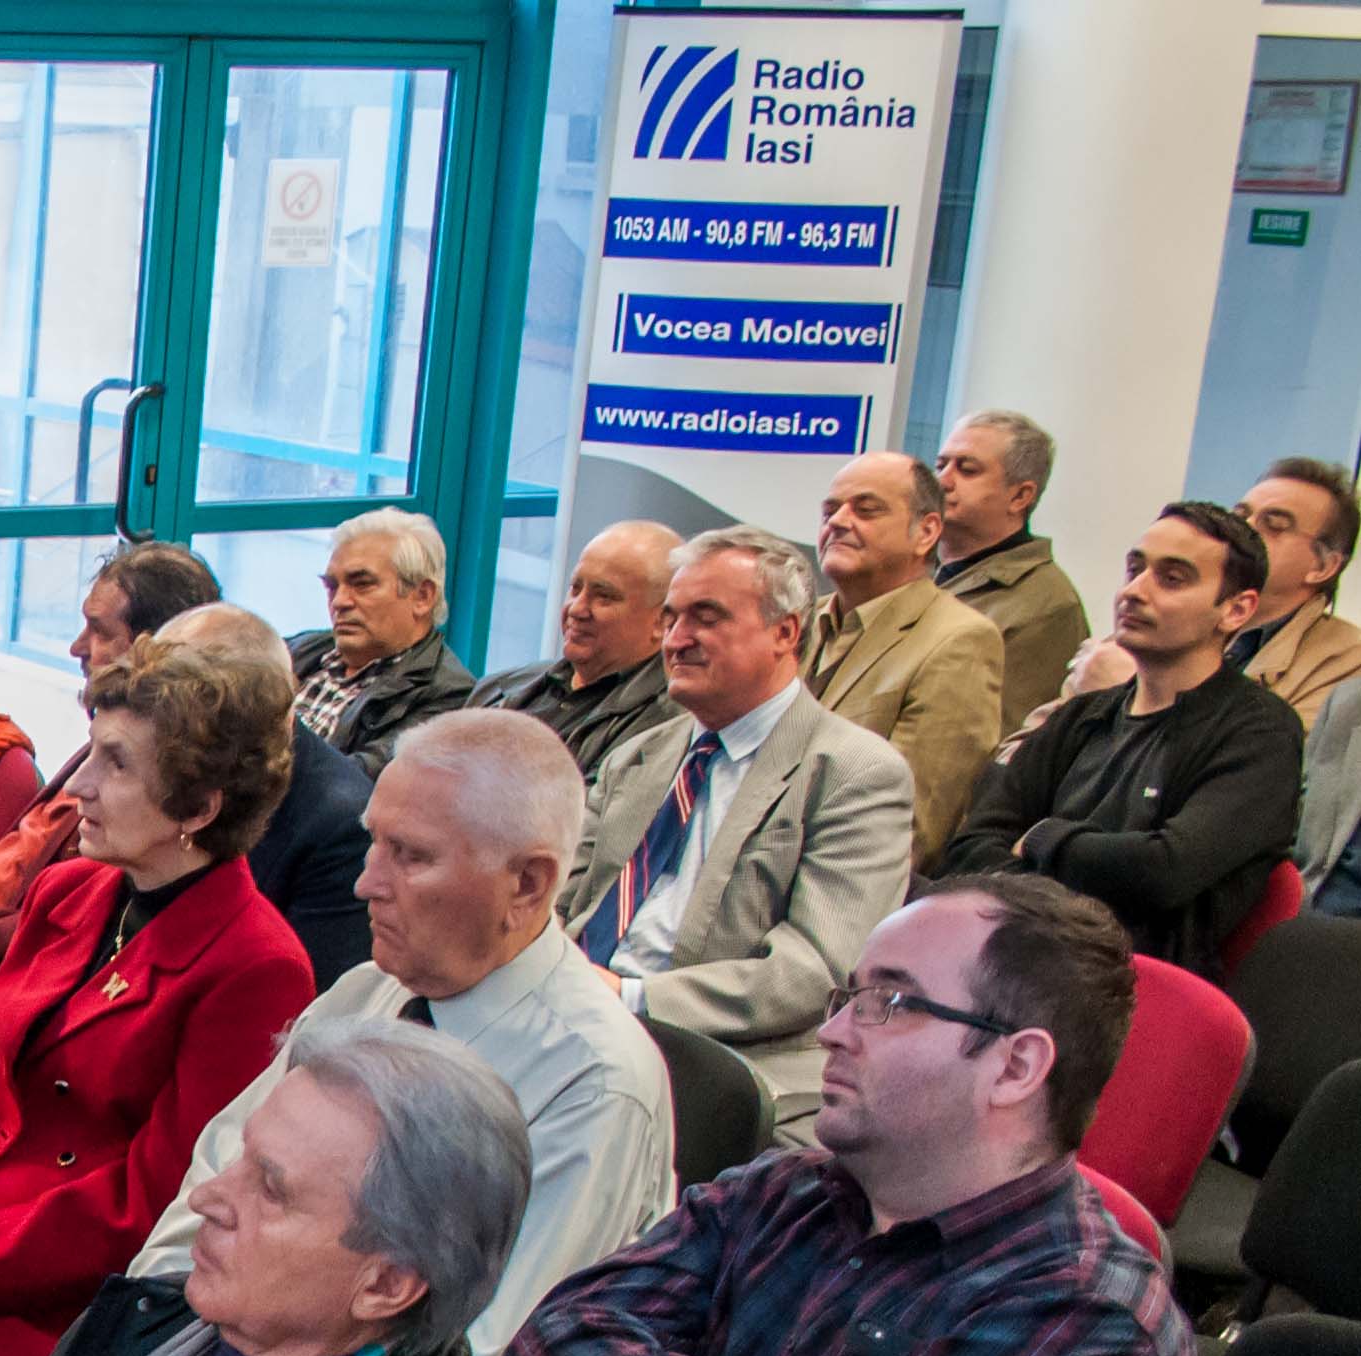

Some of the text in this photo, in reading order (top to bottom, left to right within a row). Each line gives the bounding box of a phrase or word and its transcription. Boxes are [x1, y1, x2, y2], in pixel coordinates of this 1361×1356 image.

[753, 59, 865, 91] Radio
[749, 95, 917, 128] România
[745, 132, 814, 164] Iasi
[613, 216, 655, 242] 1053
[657, 218, 690, 243] AM
[705, 220, 748, 249] 90,8
[752, 221, 785, 247] FM
[799, 222, 842, 252] 96,3
[845, 223, 877, 249] FM
[633, 312, 888, 347] Vocea Moldovei
[594, 406, 840, 437] www.radioiasi.ro
